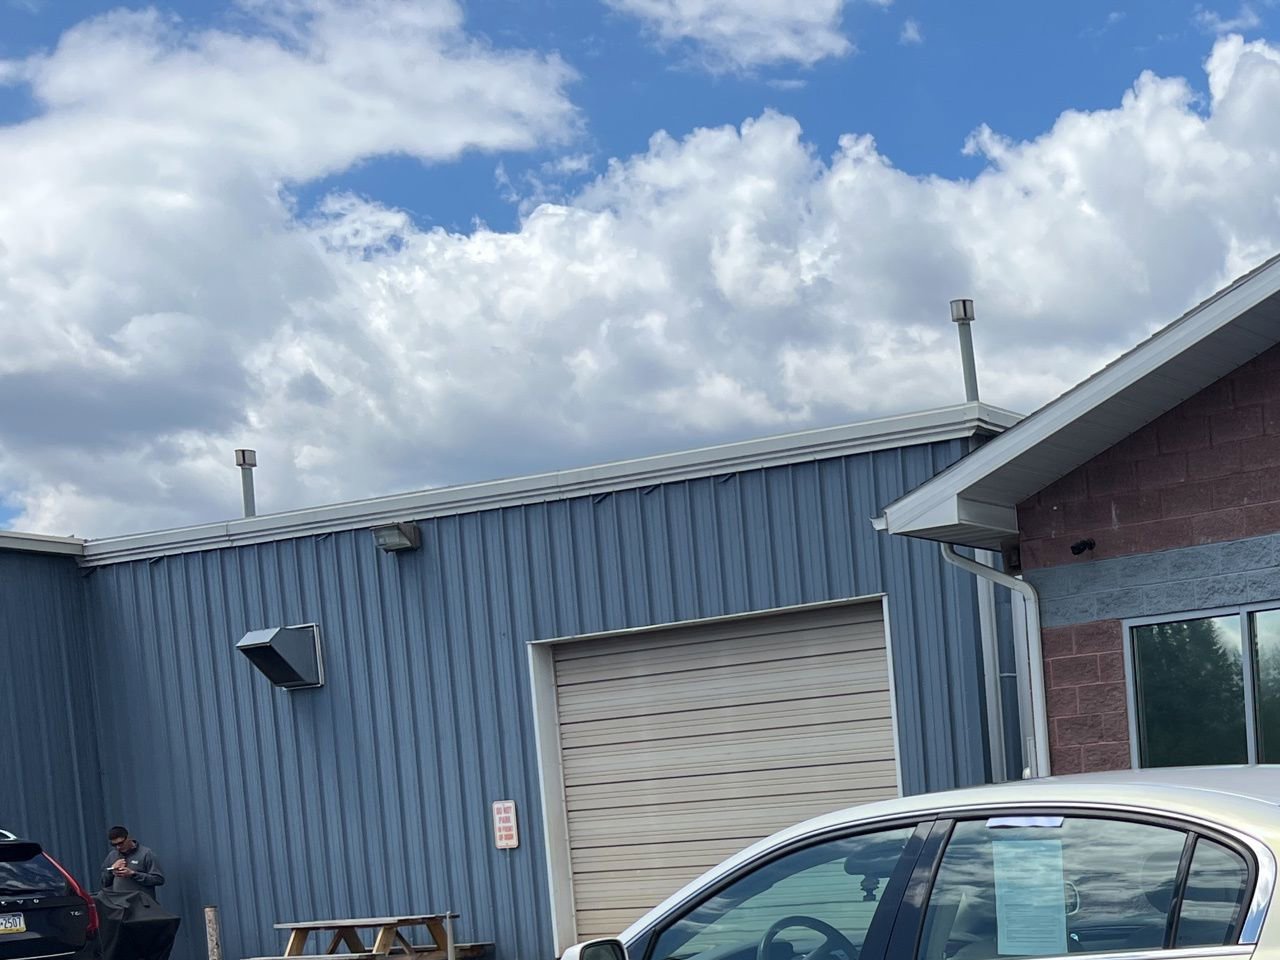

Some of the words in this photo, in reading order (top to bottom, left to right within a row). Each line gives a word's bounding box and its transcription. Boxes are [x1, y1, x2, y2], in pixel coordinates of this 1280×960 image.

[496, 807, 502, 815] DO
[503, 806, 512, 814] NOT
[499, 816, 511, 824] PARK
